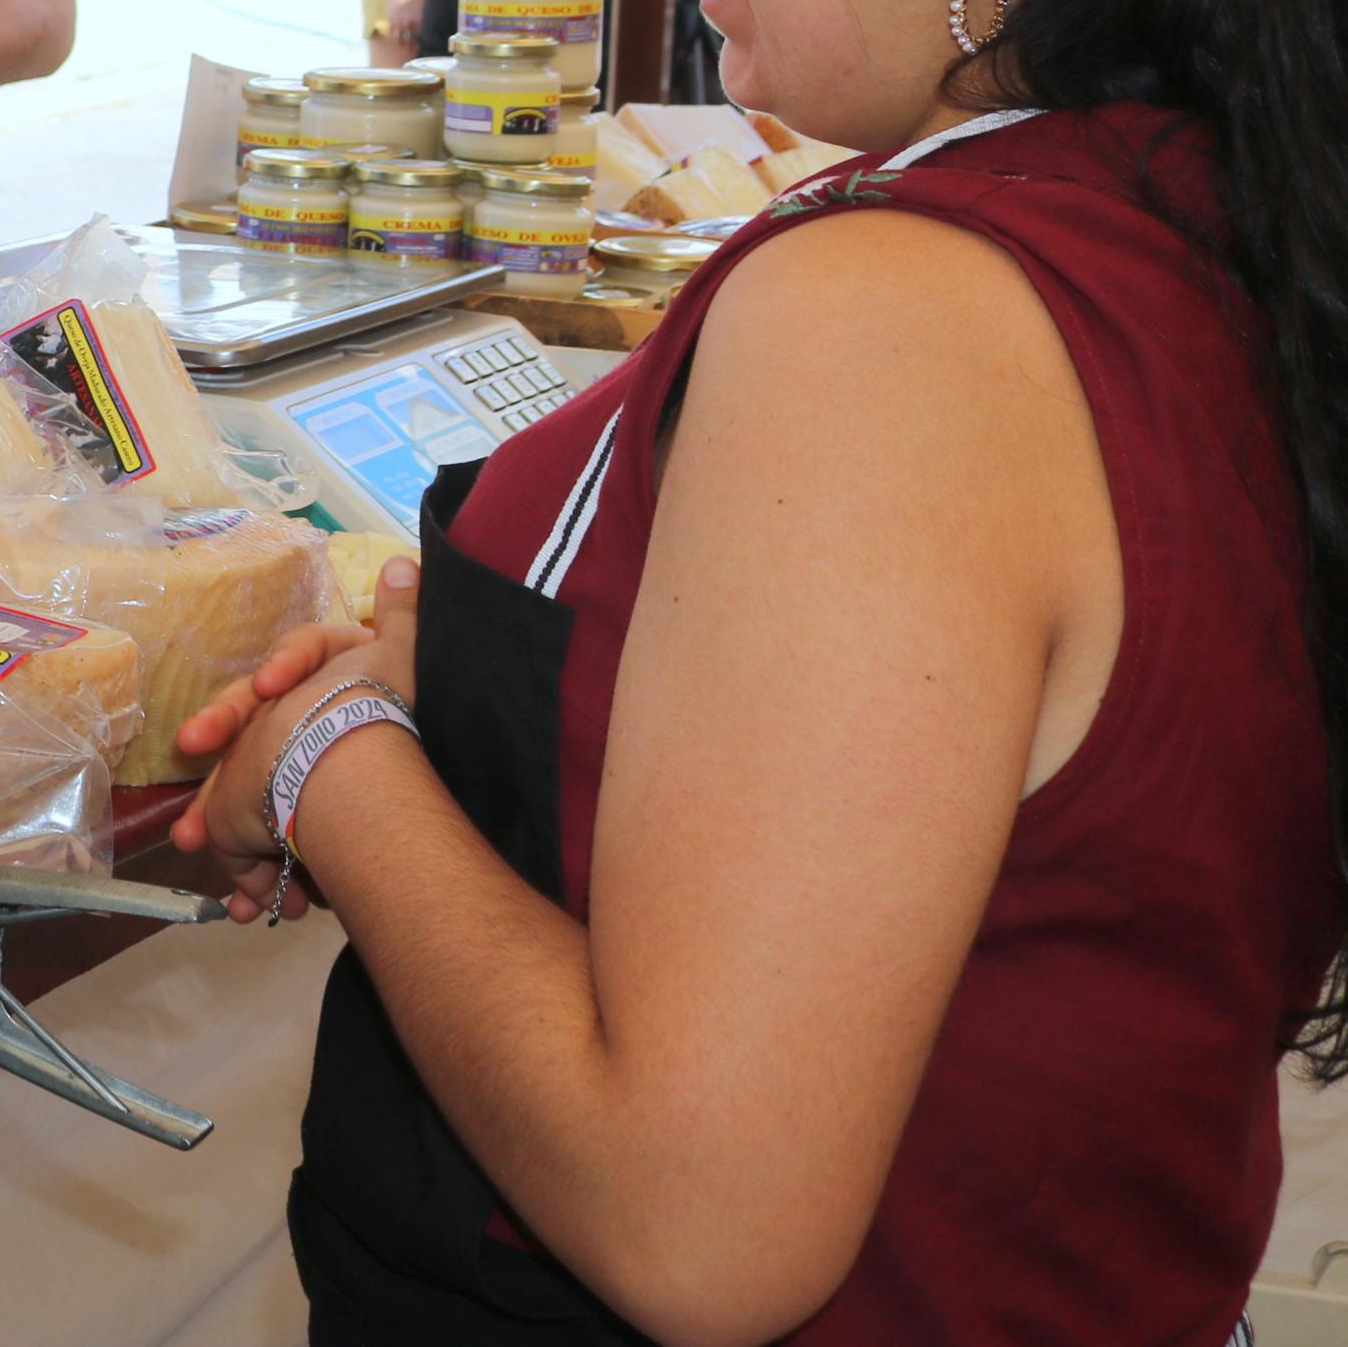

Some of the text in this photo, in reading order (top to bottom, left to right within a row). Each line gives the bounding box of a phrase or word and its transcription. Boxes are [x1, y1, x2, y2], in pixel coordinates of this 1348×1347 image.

[516, 5, 572, 16] QUESO
[546, 156, 582, 167] VEJA
[264, 208, 282, 218] DE
[382, 219, 442, 230] CREMA
[473, 228, 508, 240] UESO
[518, 232, 541, 242] DE
[63, 314, 77, 338] Queso
[77, 346, 91, 369] Oveja
[104, 404, 123, 442] Artesano
[120, 438, 135, 467] Casero
[274, 757, 306, 810] SAN
[337, 698, 389, 727] 2024
